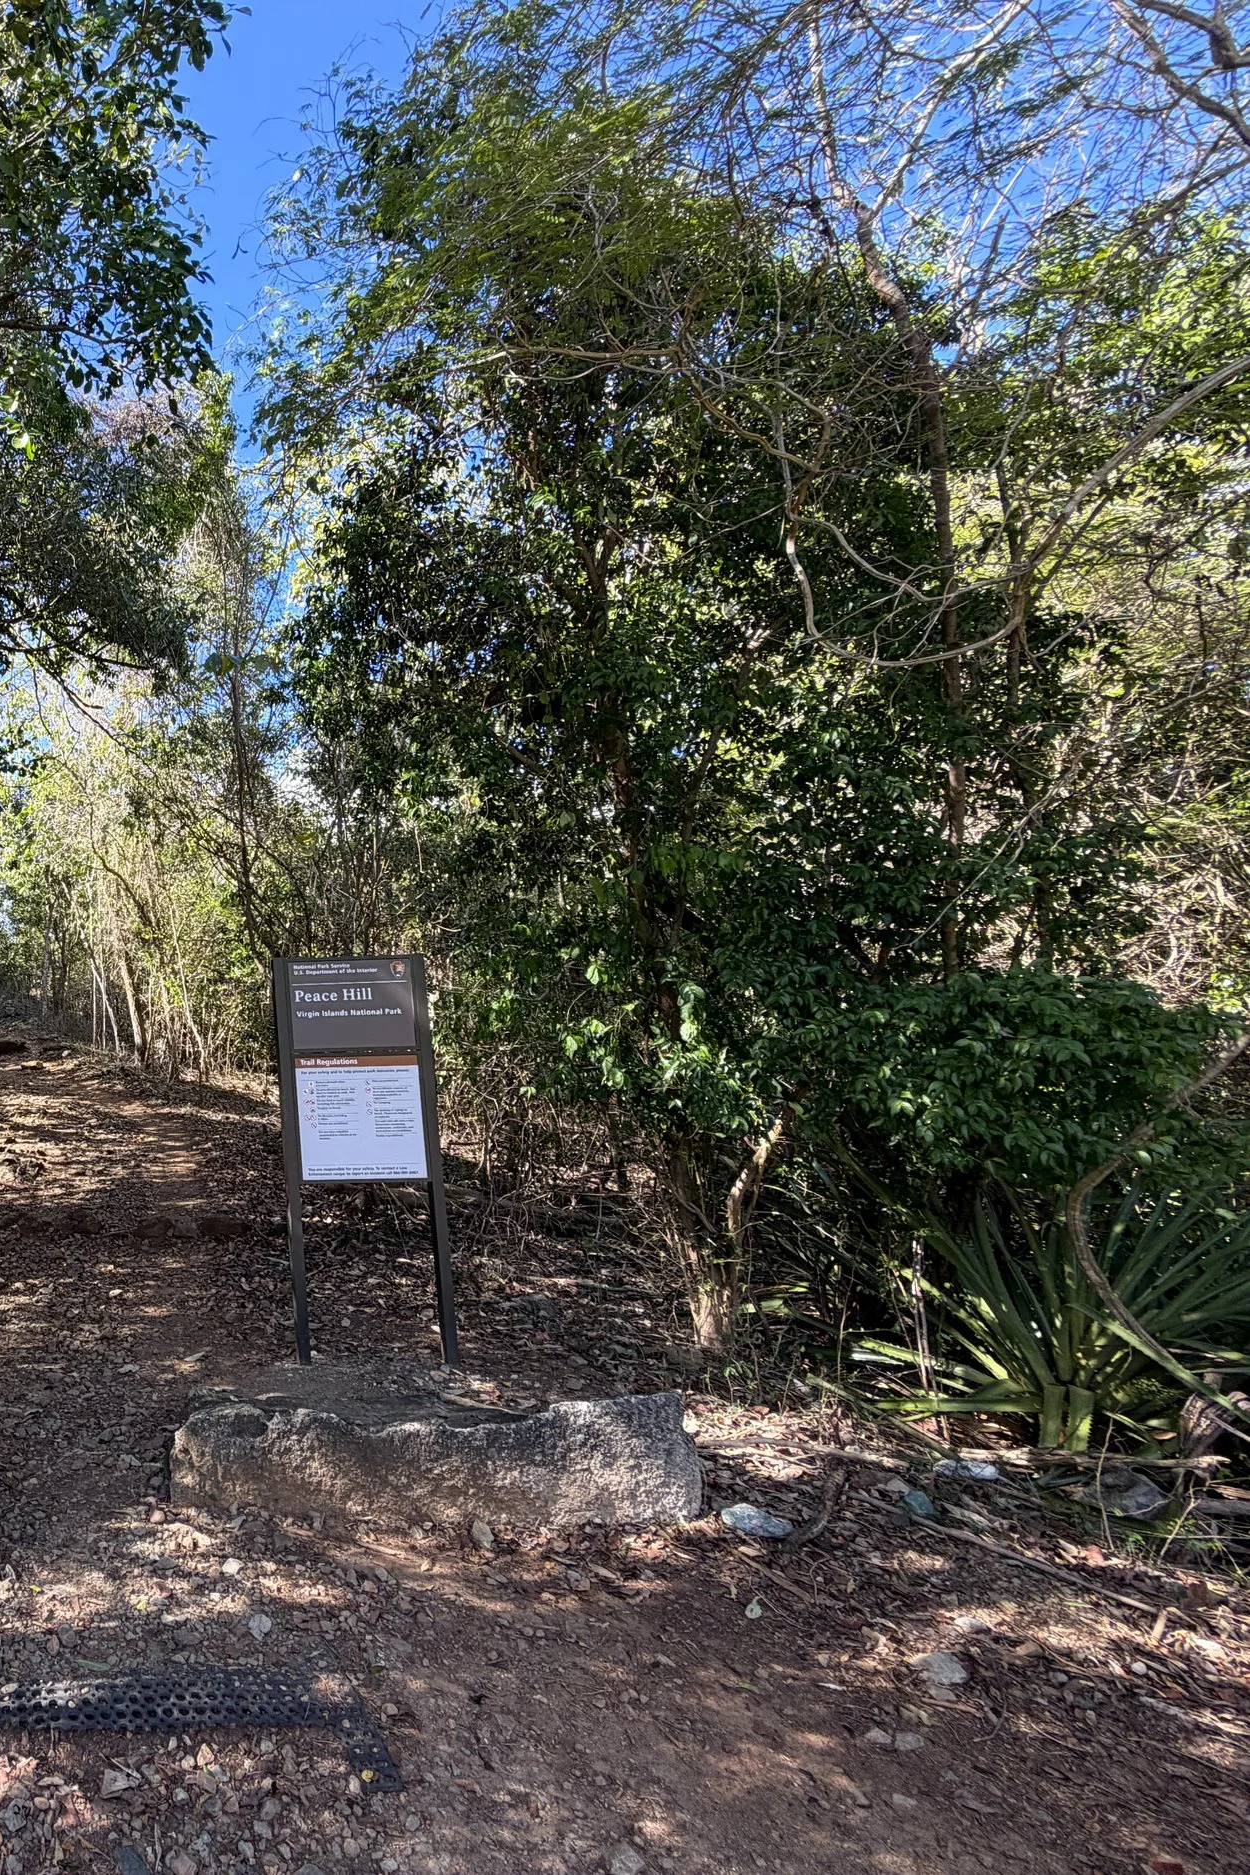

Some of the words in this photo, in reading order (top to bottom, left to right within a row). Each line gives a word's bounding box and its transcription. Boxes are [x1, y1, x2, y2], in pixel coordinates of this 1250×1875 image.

[294, 990, 338, 1002] Peace
[342, 987, 373, 1001] Hill
[296, 1010, 320, 1019] Virgin
[321, 1009, 348, 1017] Islands
[350, 1008, 383, 1016] National
[385, 1007, 403, 1015] Park
[316, 1058, 358, 1067] Regulations
